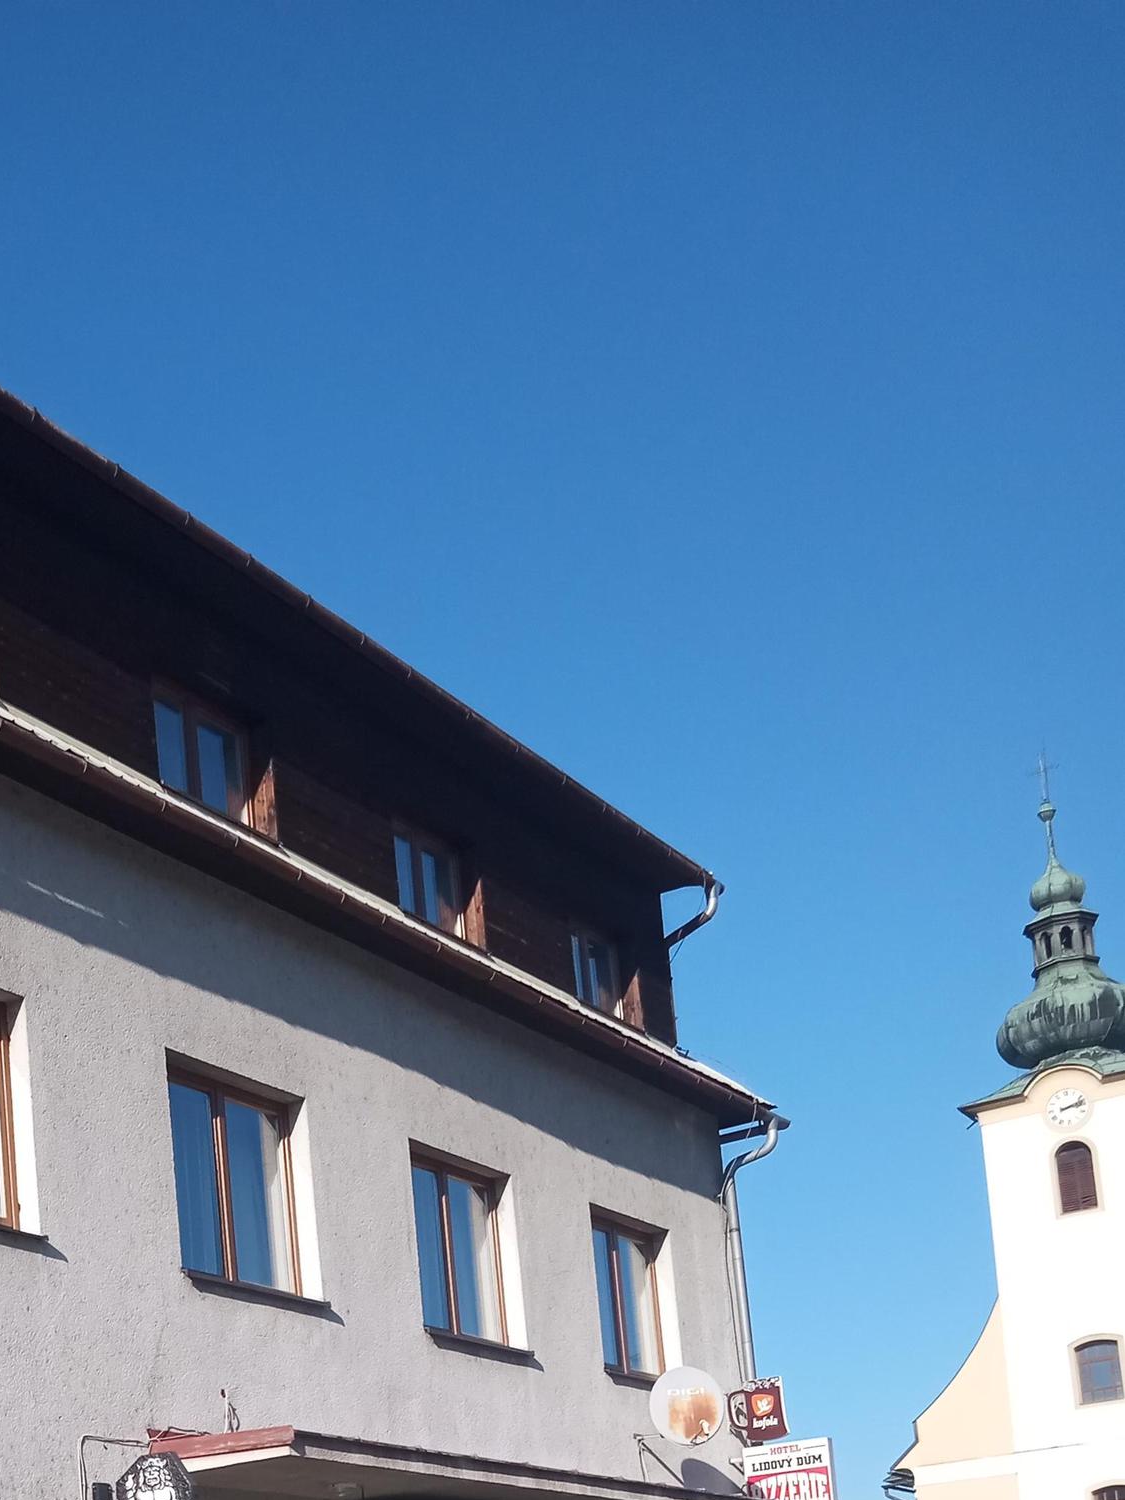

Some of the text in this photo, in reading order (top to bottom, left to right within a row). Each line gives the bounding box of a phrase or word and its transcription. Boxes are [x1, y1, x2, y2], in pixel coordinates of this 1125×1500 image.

[770, 1444, 801, 1455] HOTEL
[752, 1453, 822, 1472] LIDOVÝ DŮM
